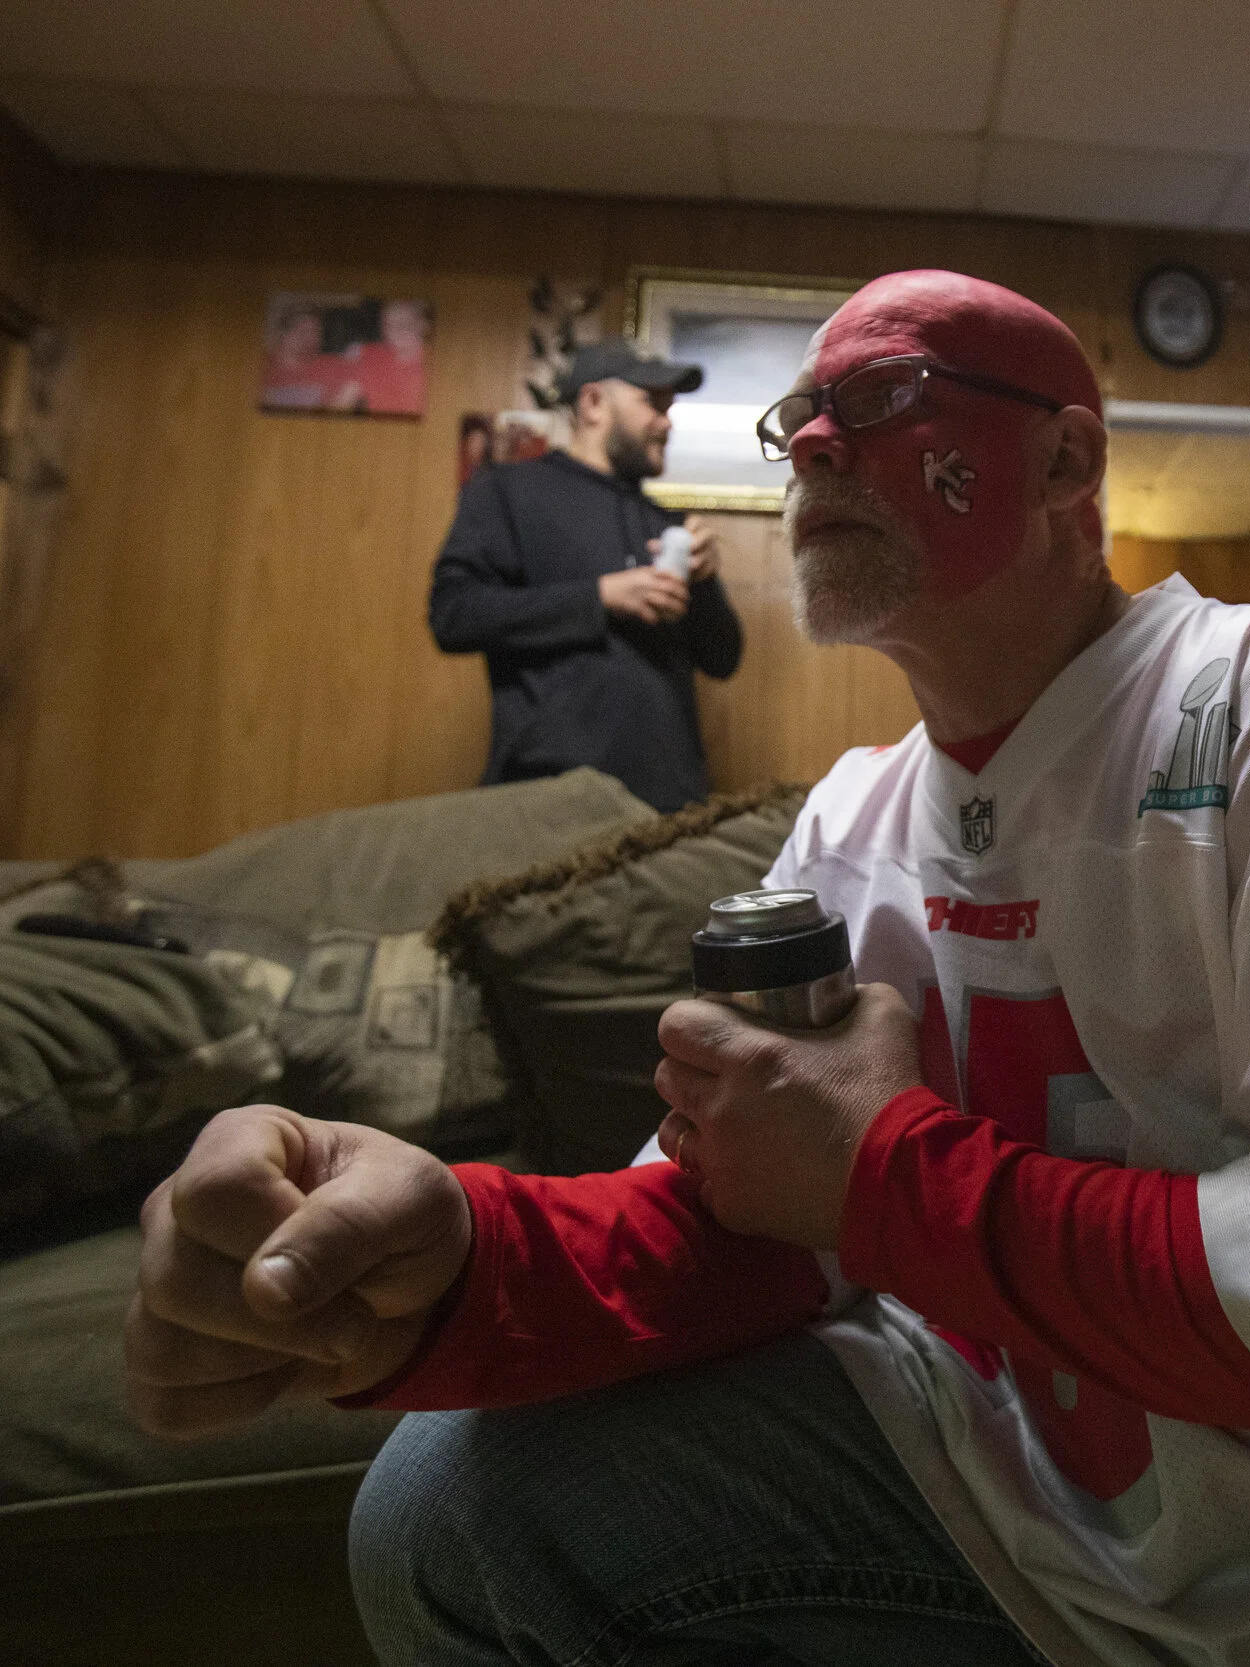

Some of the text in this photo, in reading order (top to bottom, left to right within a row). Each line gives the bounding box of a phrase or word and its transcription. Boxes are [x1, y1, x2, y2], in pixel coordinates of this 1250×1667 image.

[922, 449, 977, 515] KC
[1146, 791, 1197, 806] SUPER
[963, 820, 992, 849] NFL
[924, 896, 1040, 940] HIEFS
